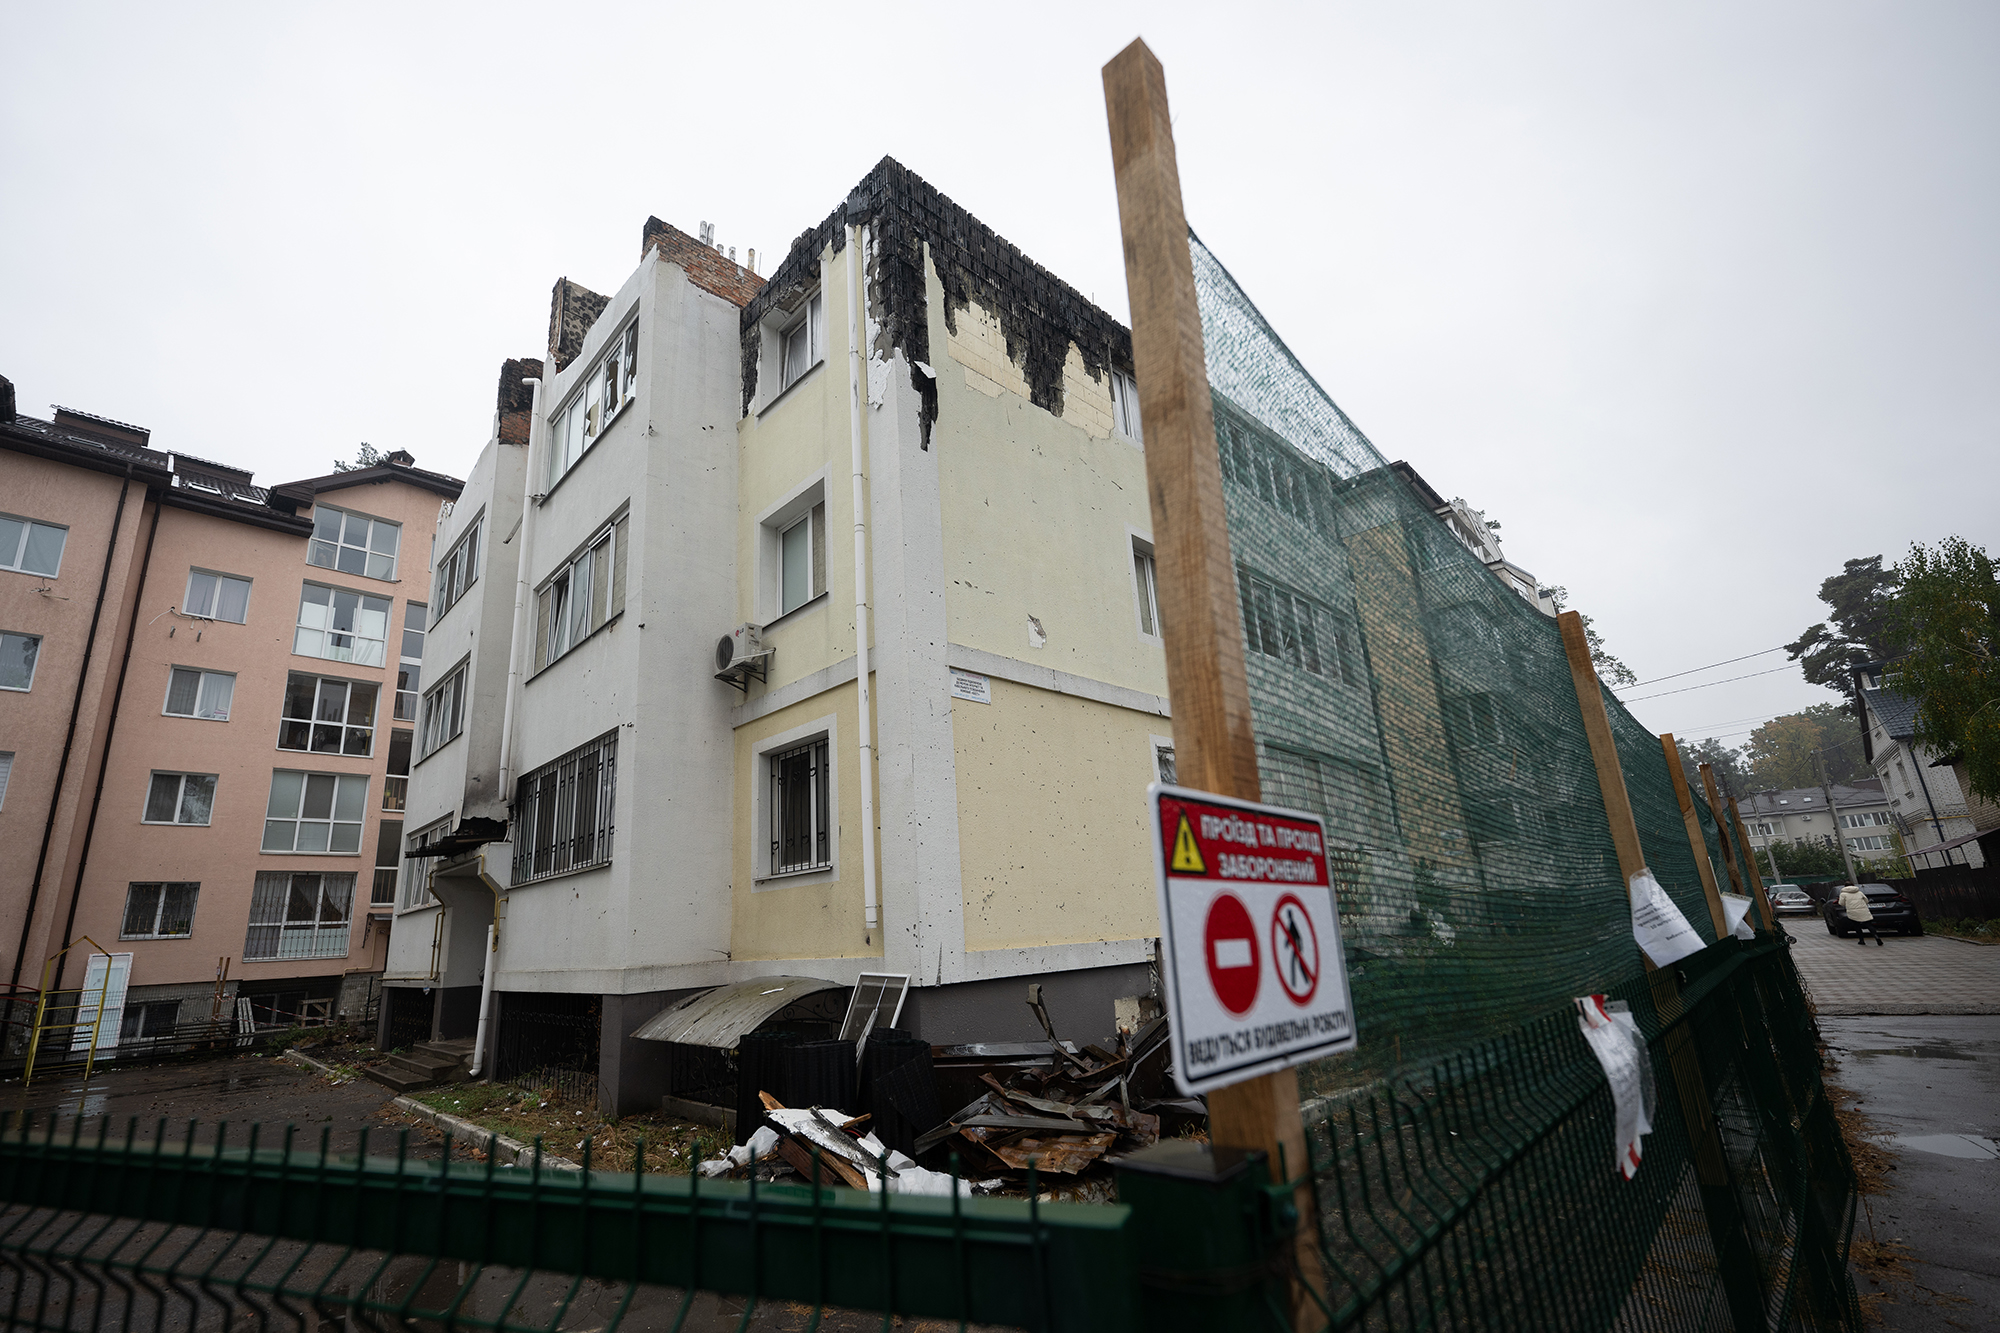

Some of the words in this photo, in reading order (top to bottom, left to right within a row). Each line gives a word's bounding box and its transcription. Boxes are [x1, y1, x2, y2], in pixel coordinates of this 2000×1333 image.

[1201, 815, 1258, 848] ПРОЇЗД
[1257, 824, 1276, 847] ТА
[1276, 827, 1321, 856] ПРОХІД
[1218, 852, 1317, 883] ЗАБОРОНЕНИЙ
[1189, 1030, 1250, 1065] ВЕДУТЬСЯ
[1254, 1019, 1310, 1048] БУДІВЕЛЬНІ
[1313, 1010, 1347, 1034] РОБОТИ
